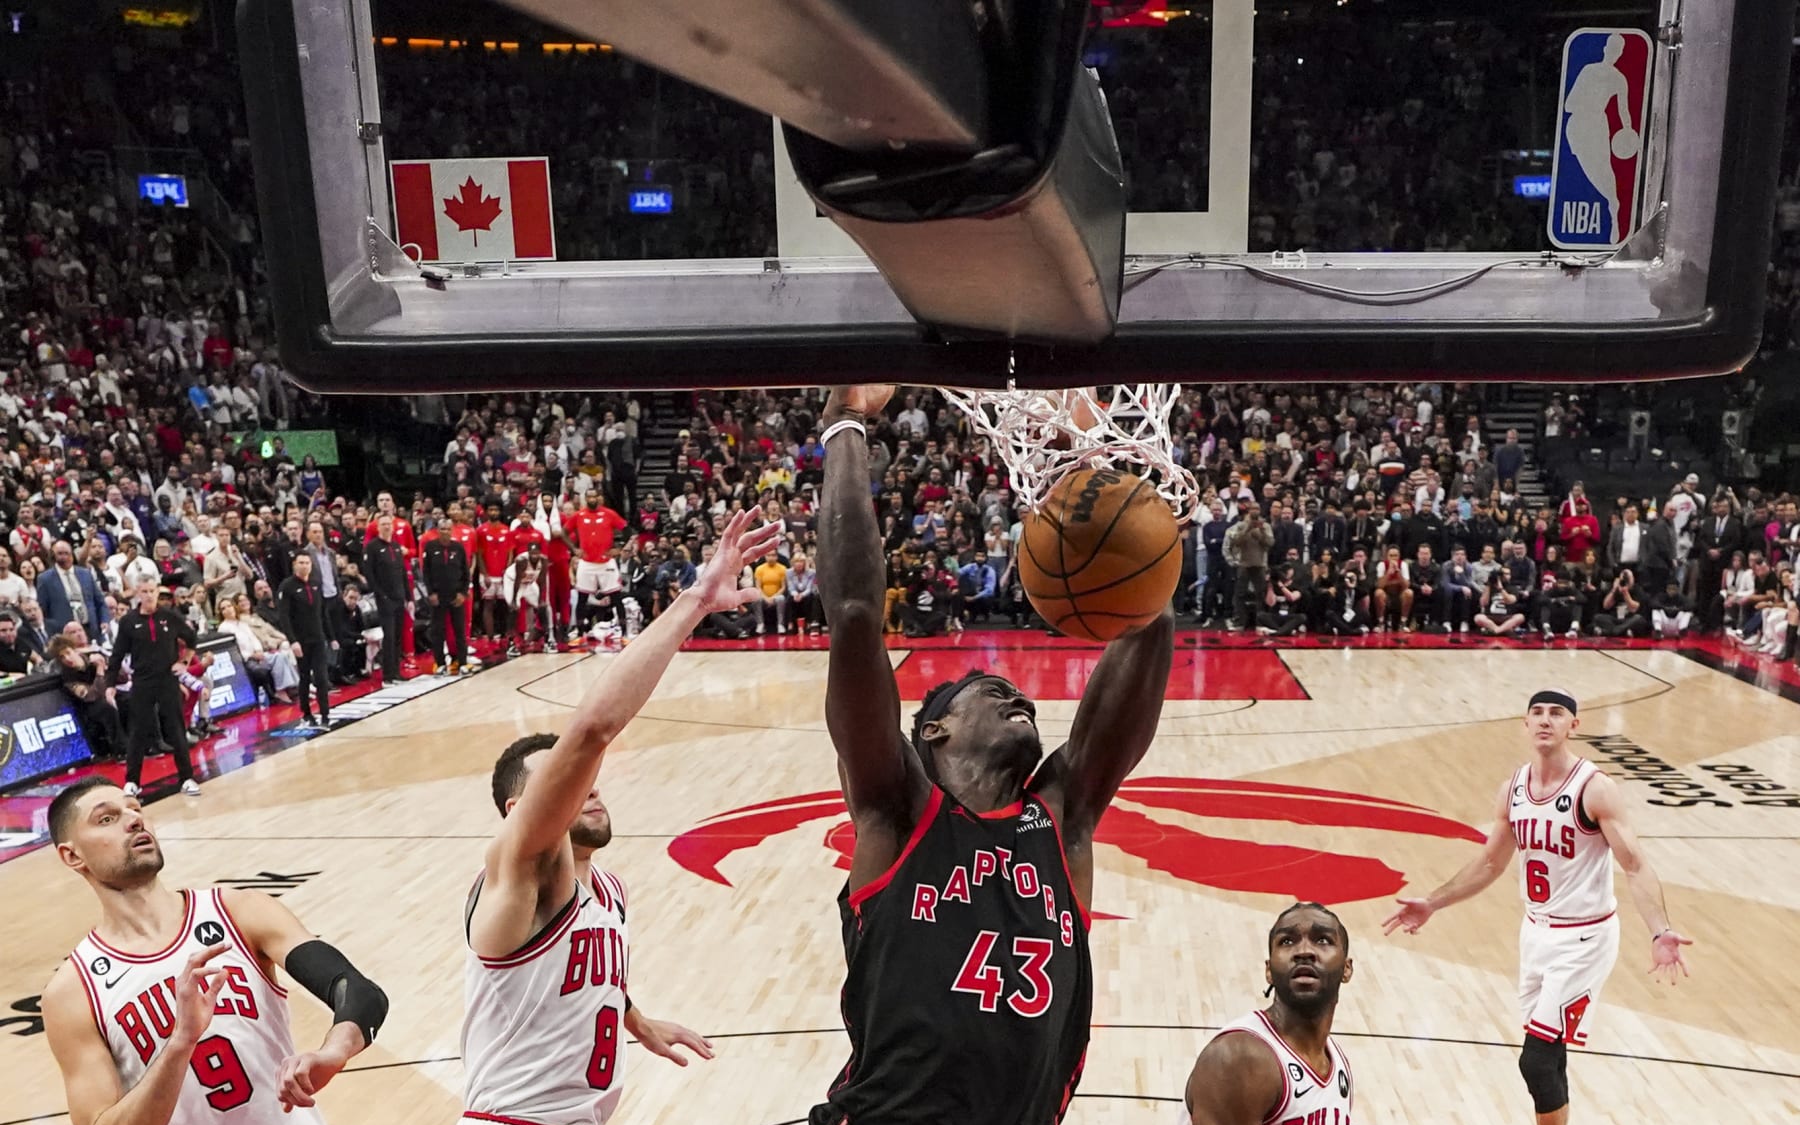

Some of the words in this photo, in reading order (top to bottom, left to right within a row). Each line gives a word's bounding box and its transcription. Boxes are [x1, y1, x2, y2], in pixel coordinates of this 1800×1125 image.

[635, 192, 666, 207] IBM
[1561, 201, 1601, 235] NBA
[1034, 817, 1053, 829] Life
[911, 846, 1074, 948] RAPTORS
[1526, 859, 1551, 904] 6
[560, 927, 628, 997] BULL
[950, 930, 1053, 1018] 43
[190, 1034, 254, 1112] 9
[585, 1005, 618, 1091] 8
